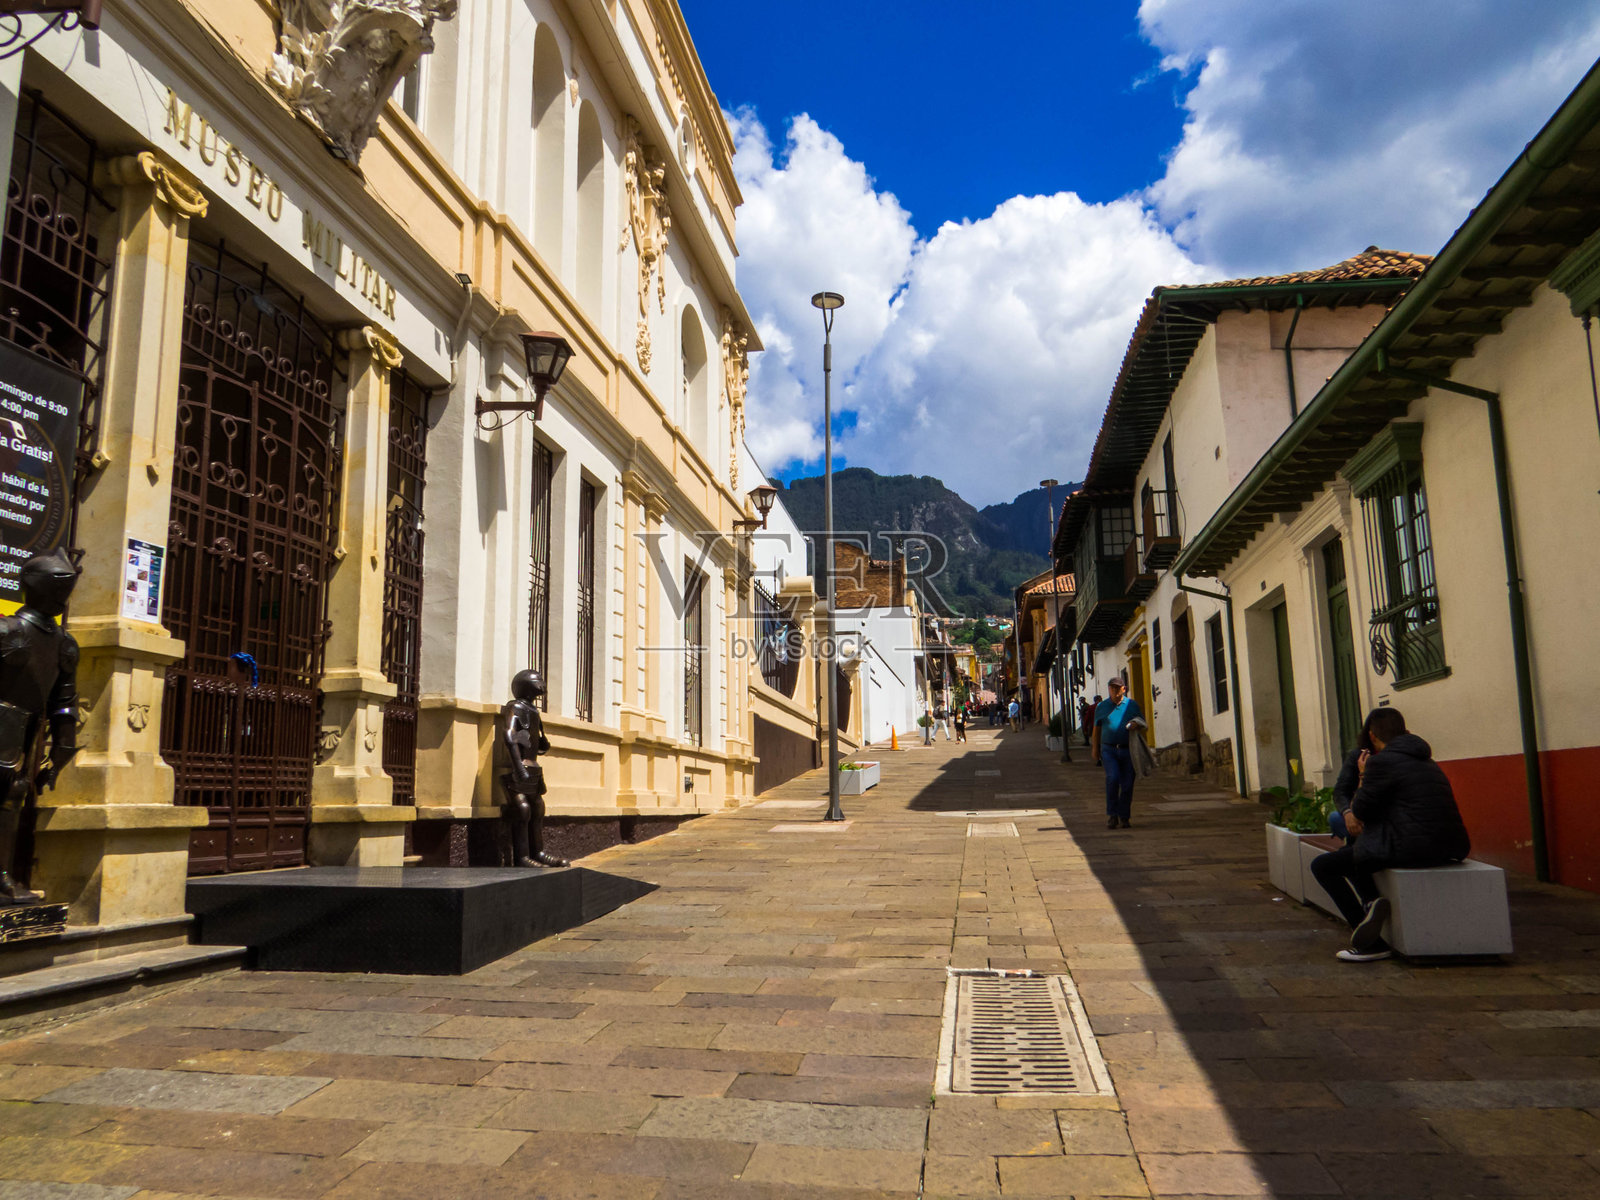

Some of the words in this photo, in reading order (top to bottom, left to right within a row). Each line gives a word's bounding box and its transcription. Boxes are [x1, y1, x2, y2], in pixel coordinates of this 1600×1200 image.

[163, 86, 283, 222] MUSEO
[302, 209, 396, 321] MILITAR
[1, 398, 22, 414] 4:00
[23, 408, 39, 421] pm
[35, 395, 47, 408] de
[48, 400, 69, 416] 9:00
[11, 437, 53, 463] Gratis!
[2, 472, 26, 489] hábil
[28, 481, 39, 493] de
[41, 485, 49, 497] la
[29, 501, 46, 512] por
